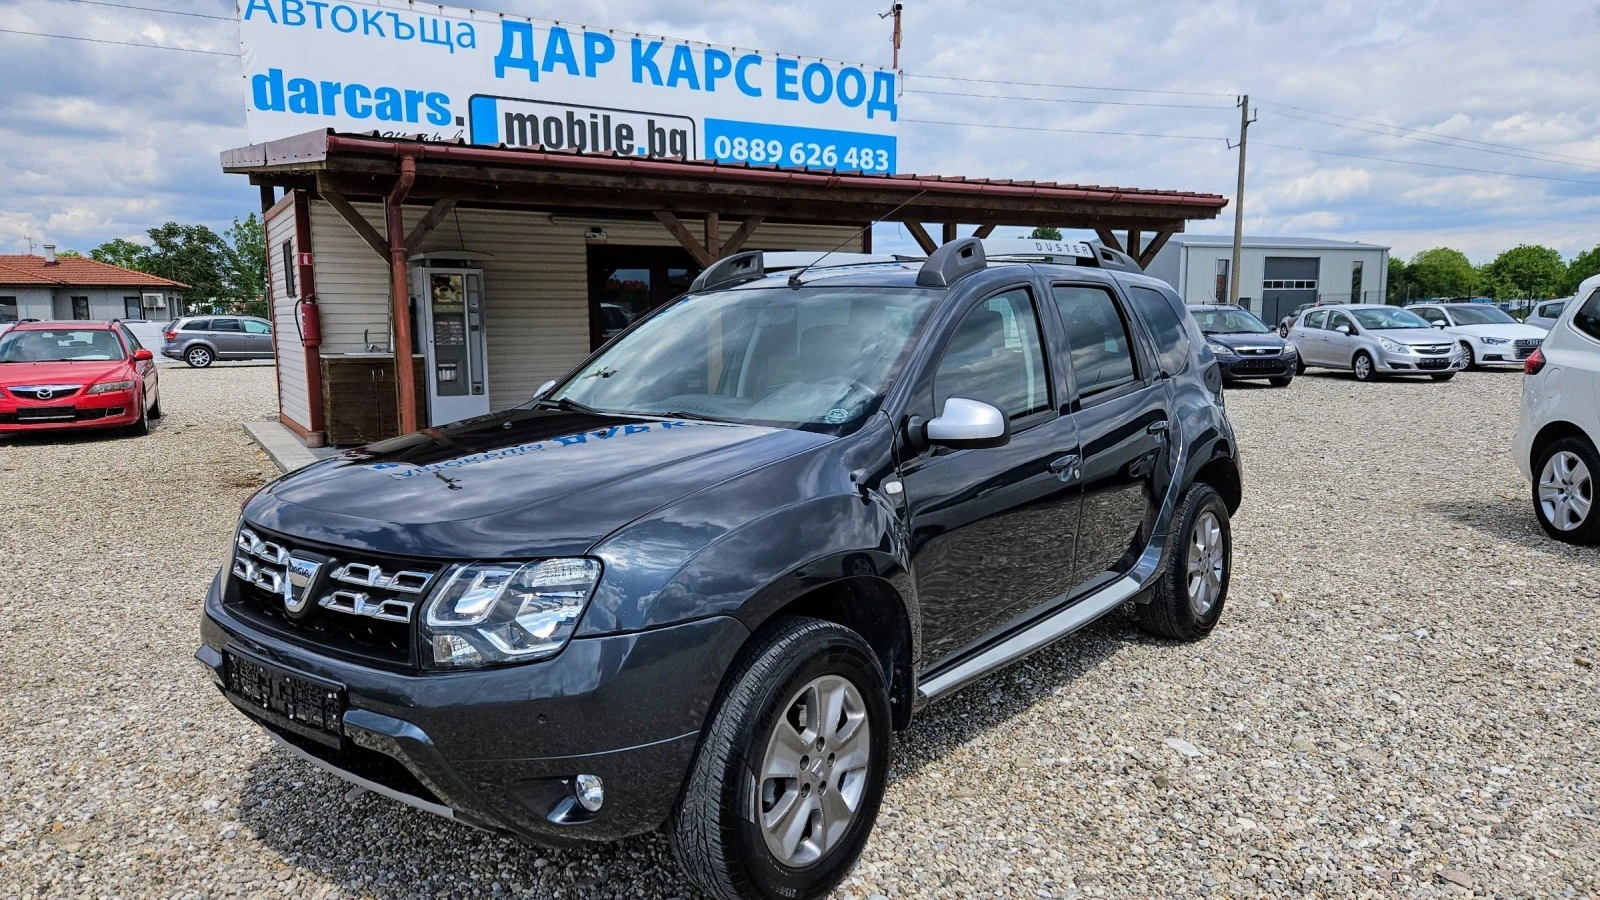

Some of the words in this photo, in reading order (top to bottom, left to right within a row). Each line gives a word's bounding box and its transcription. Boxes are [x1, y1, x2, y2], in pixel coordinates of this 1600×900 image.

[494, 19, 615, 83] ДАР
[631, 38, 762, 98] КАРС
[776, 57, 899, 122] ЕООД
[714, 135, 783, 163] 0889
[789, 142, 838, 167] 626
[843, 146, 889, 171] 483
[1035, 242, 1089, 255] DUSTER
